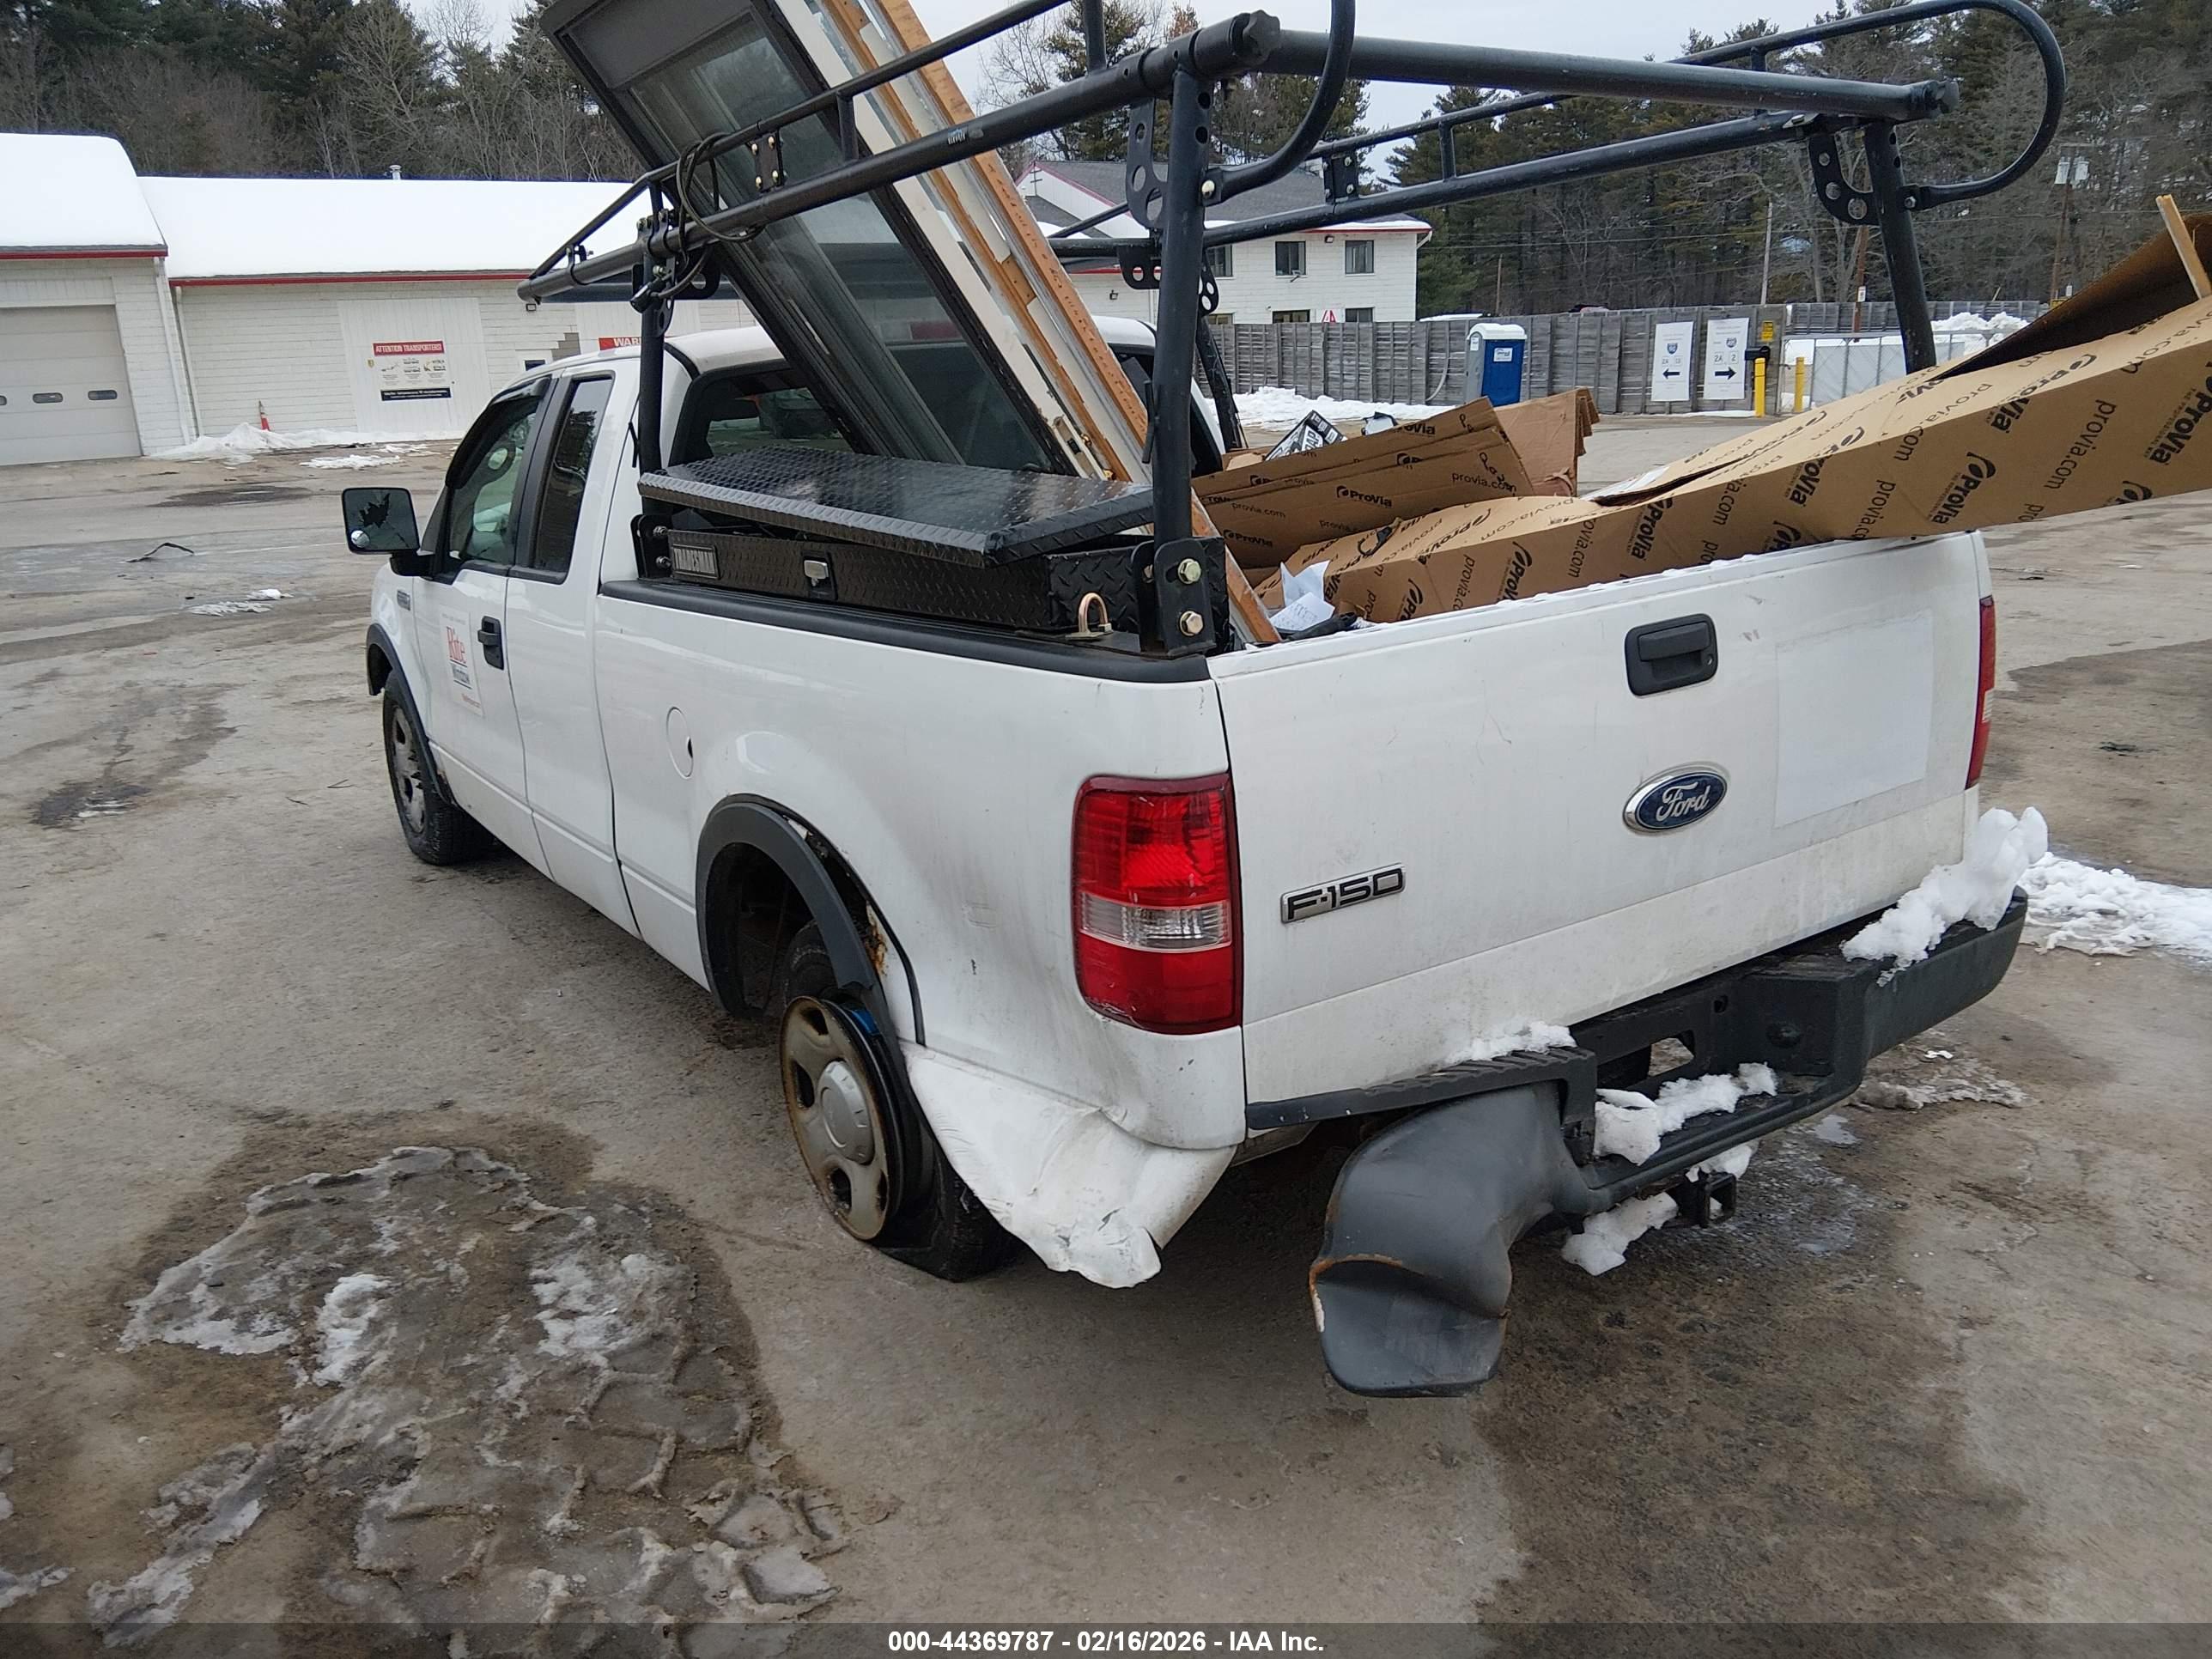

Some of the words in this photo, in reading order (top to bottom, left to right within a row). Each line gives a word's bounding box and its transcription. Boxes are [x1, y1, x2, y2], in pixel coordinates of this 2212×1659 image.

[1894, 383, 1993, 461] provia.com
[2044, 399, 2118, 489] provia.com
[2149, 391, 2212, 464] ProVia
[1350, 489, 1392, 507] ProVia
[1481, 497, 1575, 542] provia.com
[1931, 474, 1982, 525] ProVia
[1631, 503, 1663, 560] ProVia
[1656, 781, 1711, 822] Ford
[1287, 867, 1403, 921] F-150
